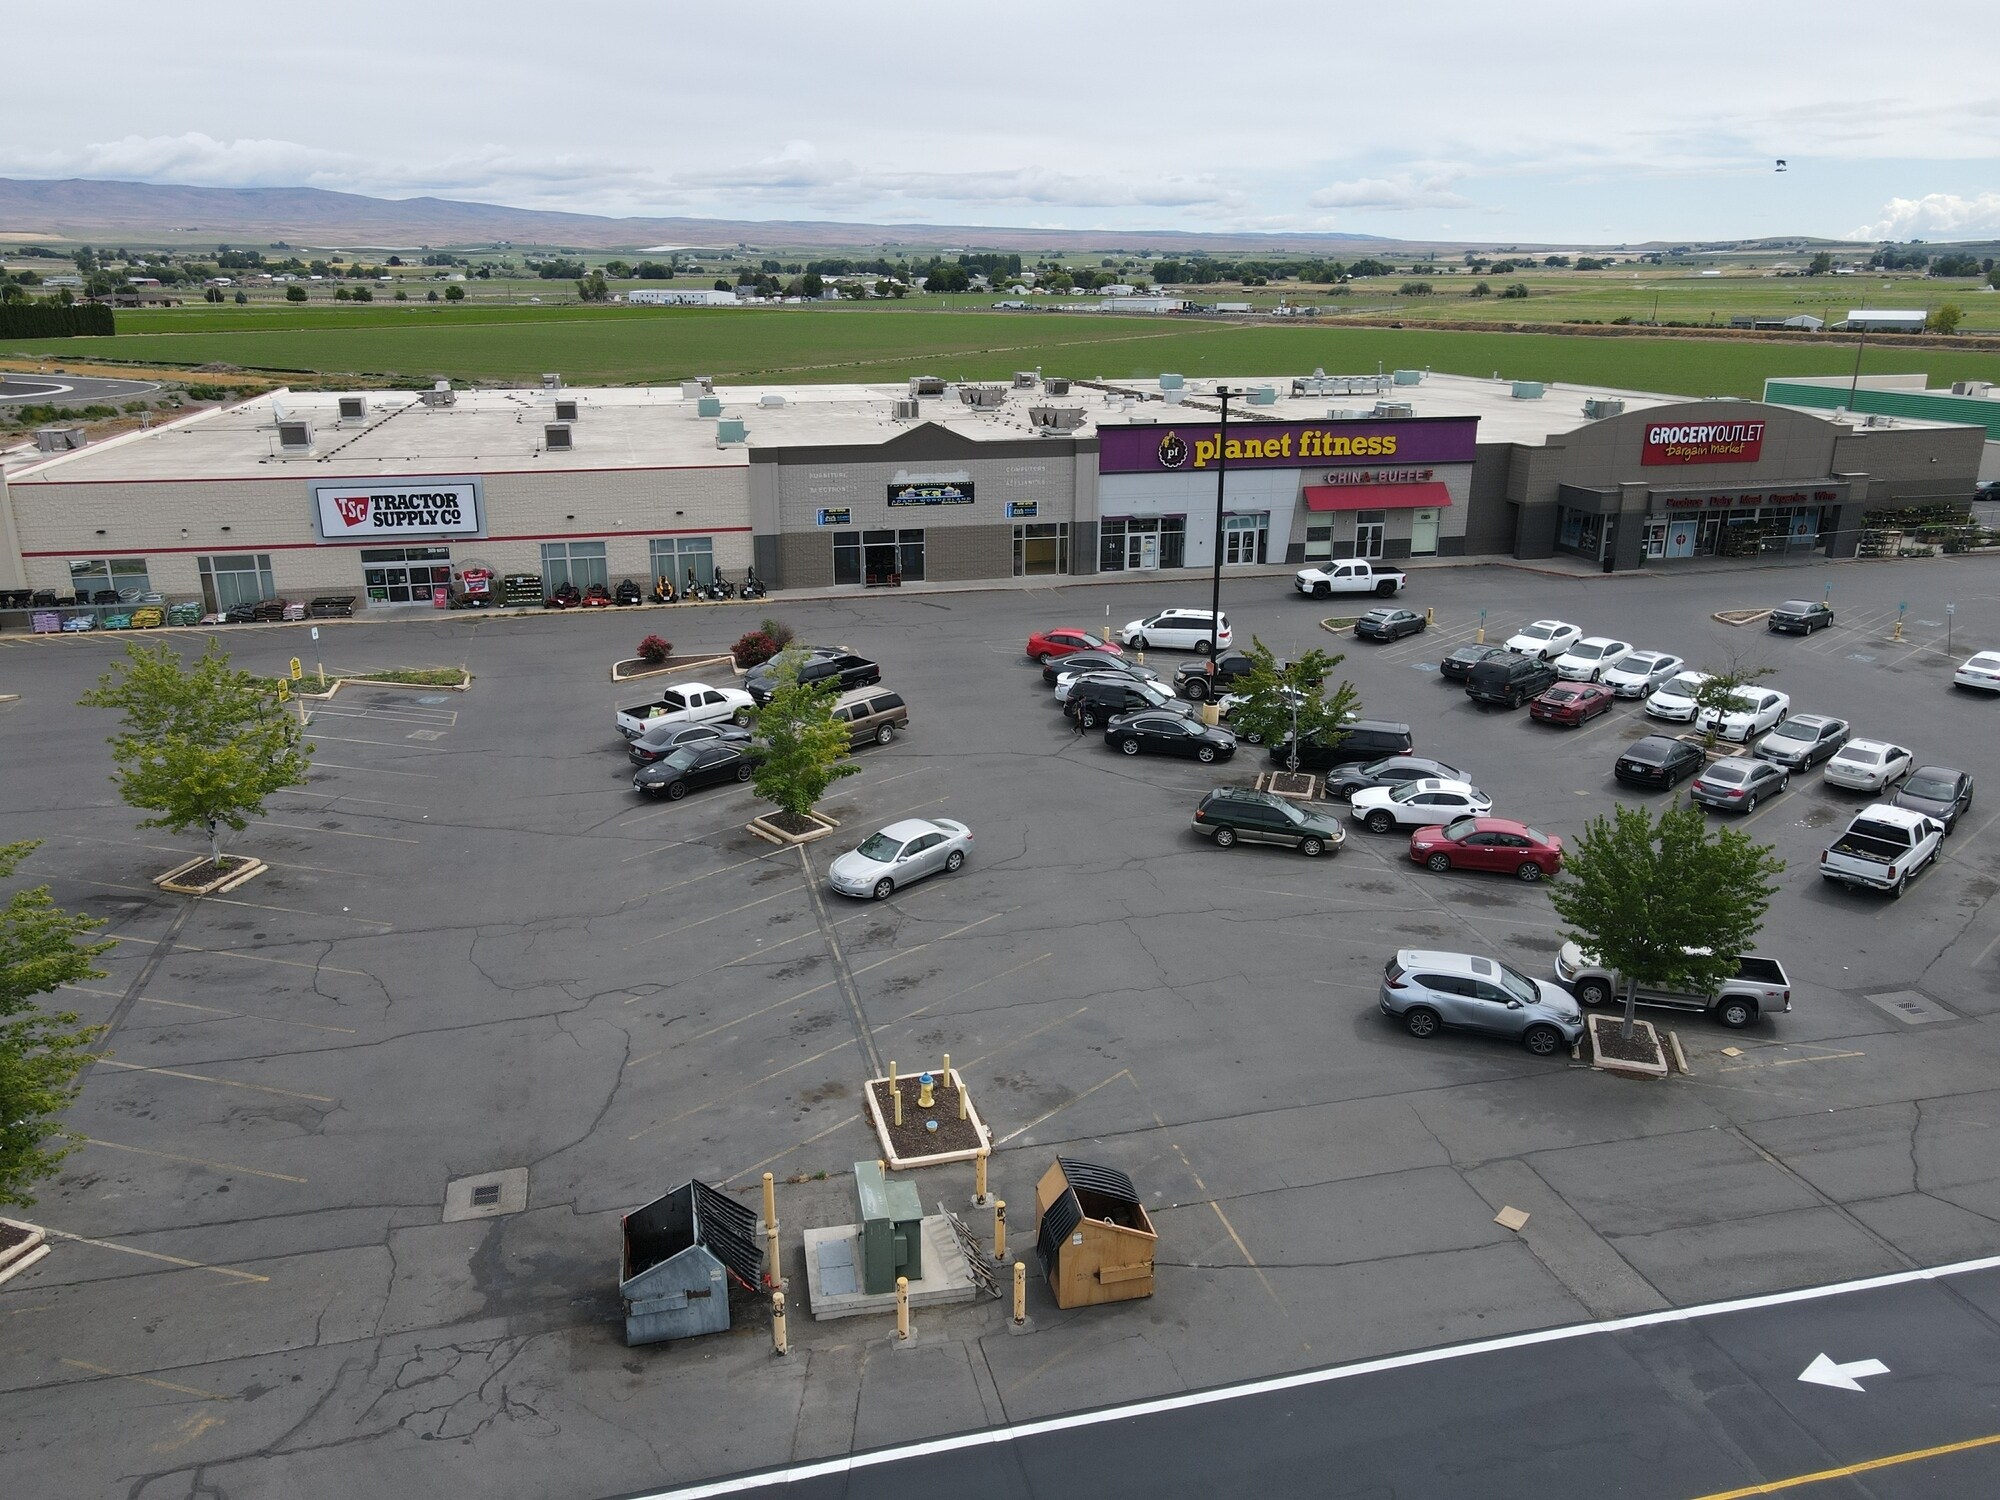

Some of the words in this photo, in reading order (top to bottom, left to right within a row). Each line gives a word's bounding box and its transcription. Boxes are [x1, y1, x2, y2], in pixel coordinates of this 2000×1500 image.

[1194, 432, 1292, 467] planet
[1298, 430, 1397, 457] fitness
[1327, 471, 1371, 484] CHINA
[1378, 469, 1433, 482] BUFFET
[338, 498, 366, 521] TSC
[370, 493, 459, 511] TRACTOR
[372, 510, 439, 527] SUPPLY
